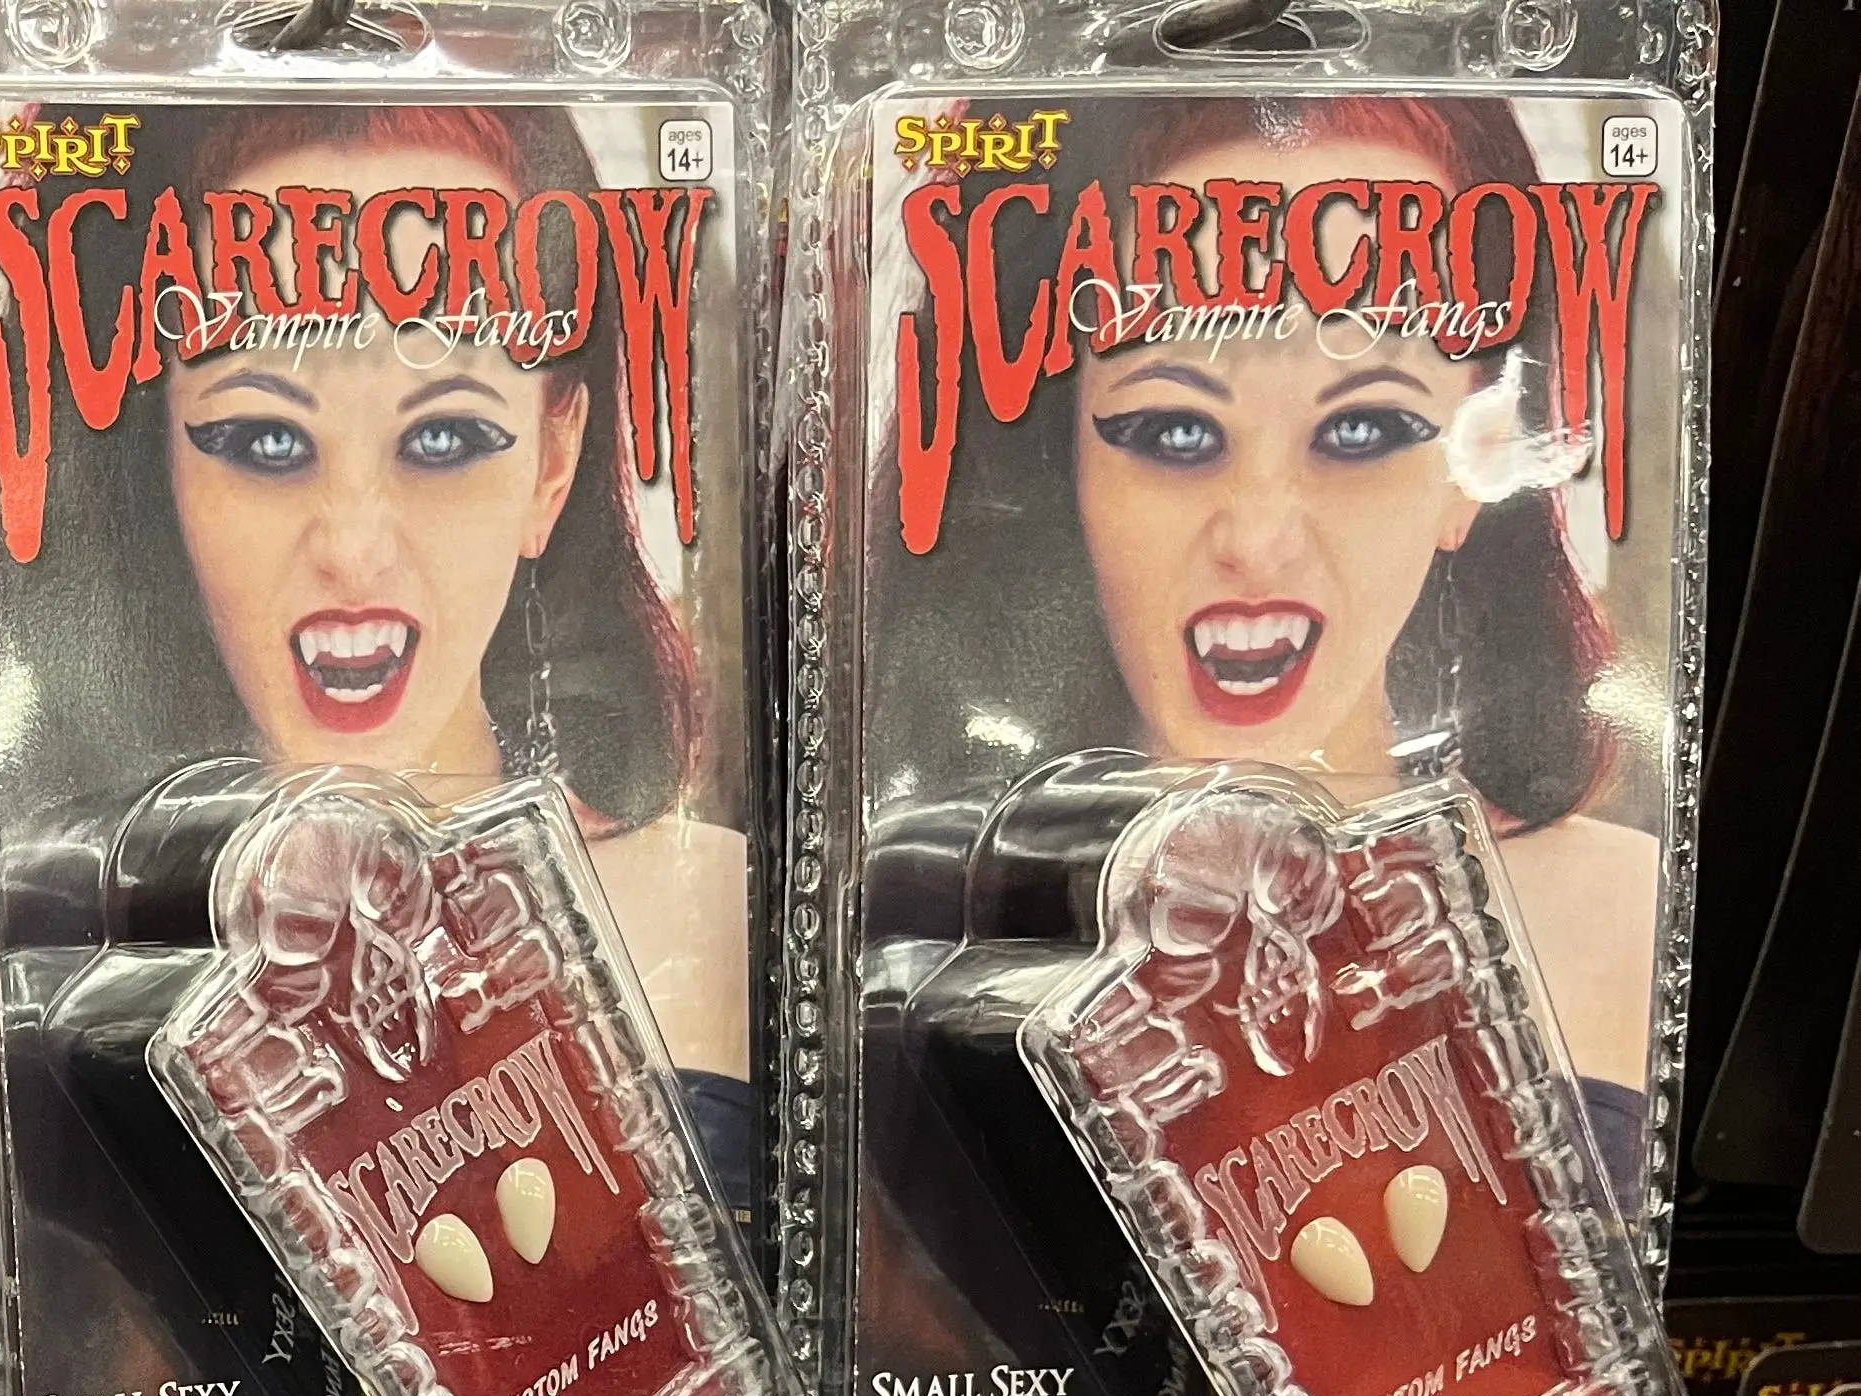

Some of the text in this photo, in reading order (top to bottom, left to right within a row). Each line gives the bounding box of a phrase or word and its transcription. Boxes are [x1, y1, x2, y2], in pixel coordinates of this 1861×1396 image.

[666, 148, 704, 174] 14+
[667, 129, 702, 145] ages
[894, 109, 1068, 176] SPIRIT
[1610, 144, 1649, 169] 14+
[1611, 126, 1647, 142] ages
[153, 285, 579, 371] Vampire Fangs
[1068, 279, 1513, 362] Vampire Fangs
[898, 178, 1656, 555] SCARECROW
[325, 1029, 620, 1335] SCARECROW
[1194, 1035, 1506, 1333] SCARECROW
[587, 1300, 659, 1371] FANGS
[1456, 1315, 1537, 1381] FANGS
